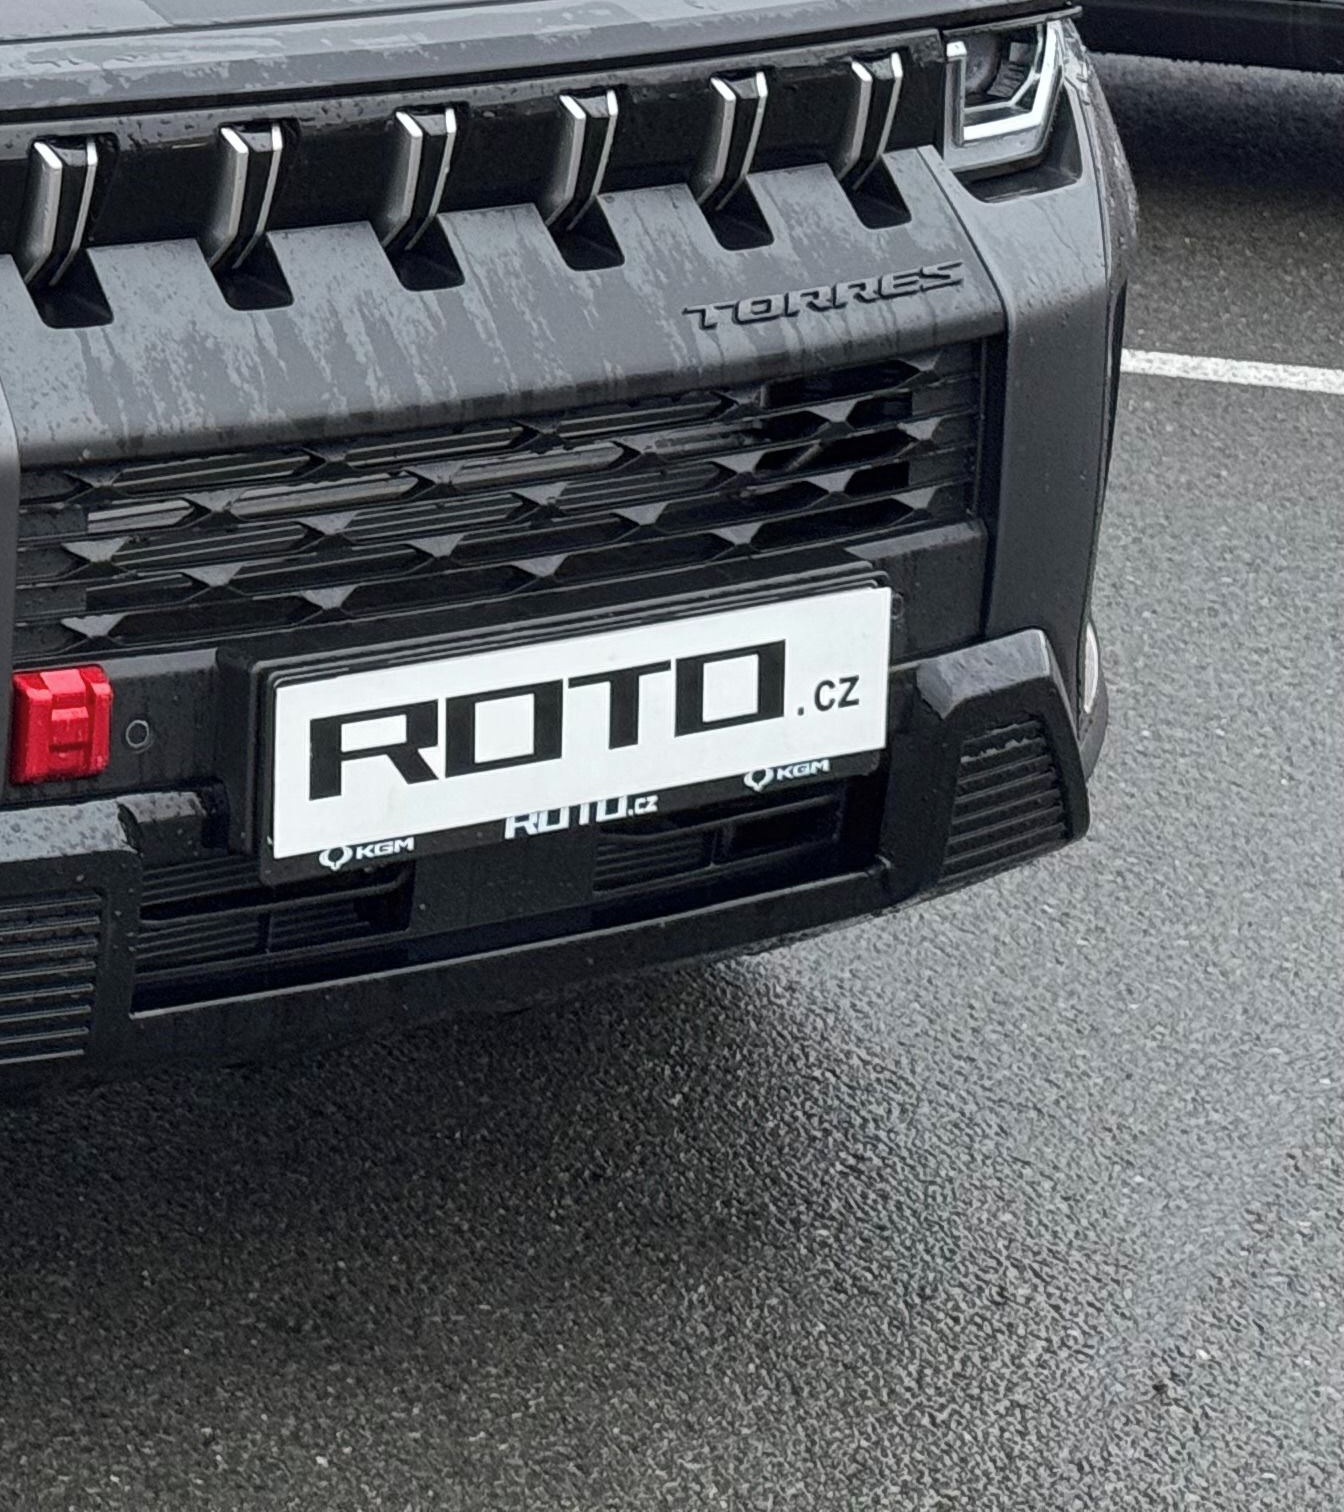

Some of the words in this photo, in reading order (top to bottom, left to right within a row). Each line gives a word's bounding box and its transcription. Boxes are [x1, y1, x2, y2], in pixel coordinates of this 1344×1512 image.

[681, 260, 965, 330] TORRES
[776, 758, 831, 781] KGM
[355, 837, 415, 860] KGM
